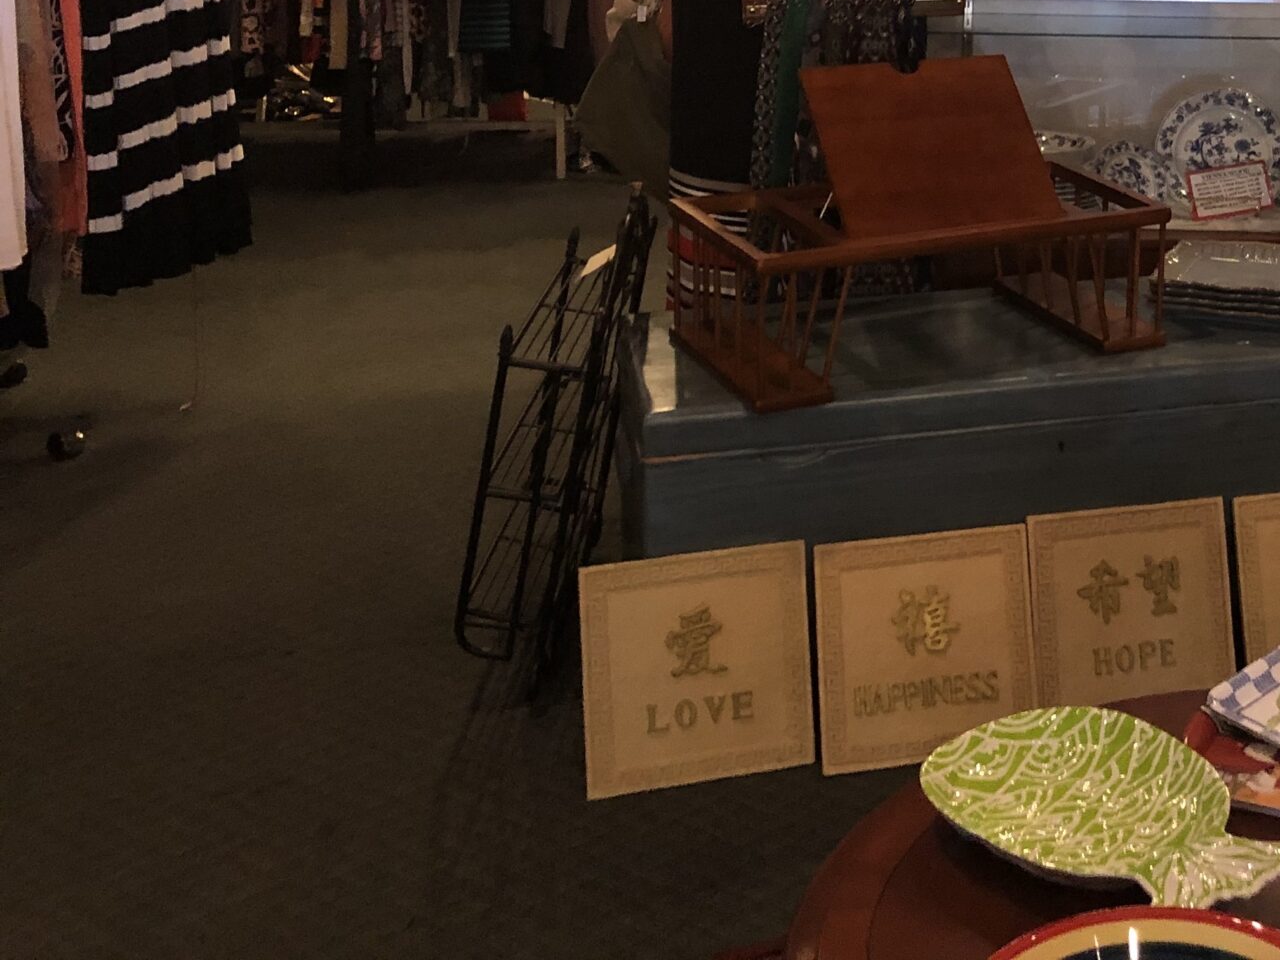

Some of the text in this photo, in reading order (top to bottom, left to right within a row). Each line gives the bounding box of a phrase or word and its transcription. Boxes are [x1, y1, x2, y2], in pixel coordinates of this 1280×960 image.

[1077, 554, 1181, 624] 希望
[1092, 640, 1176, 677] HOPE
[645, 690, 754, 736] LOVE
[853, 670, 999, 718] HAPPINESS
